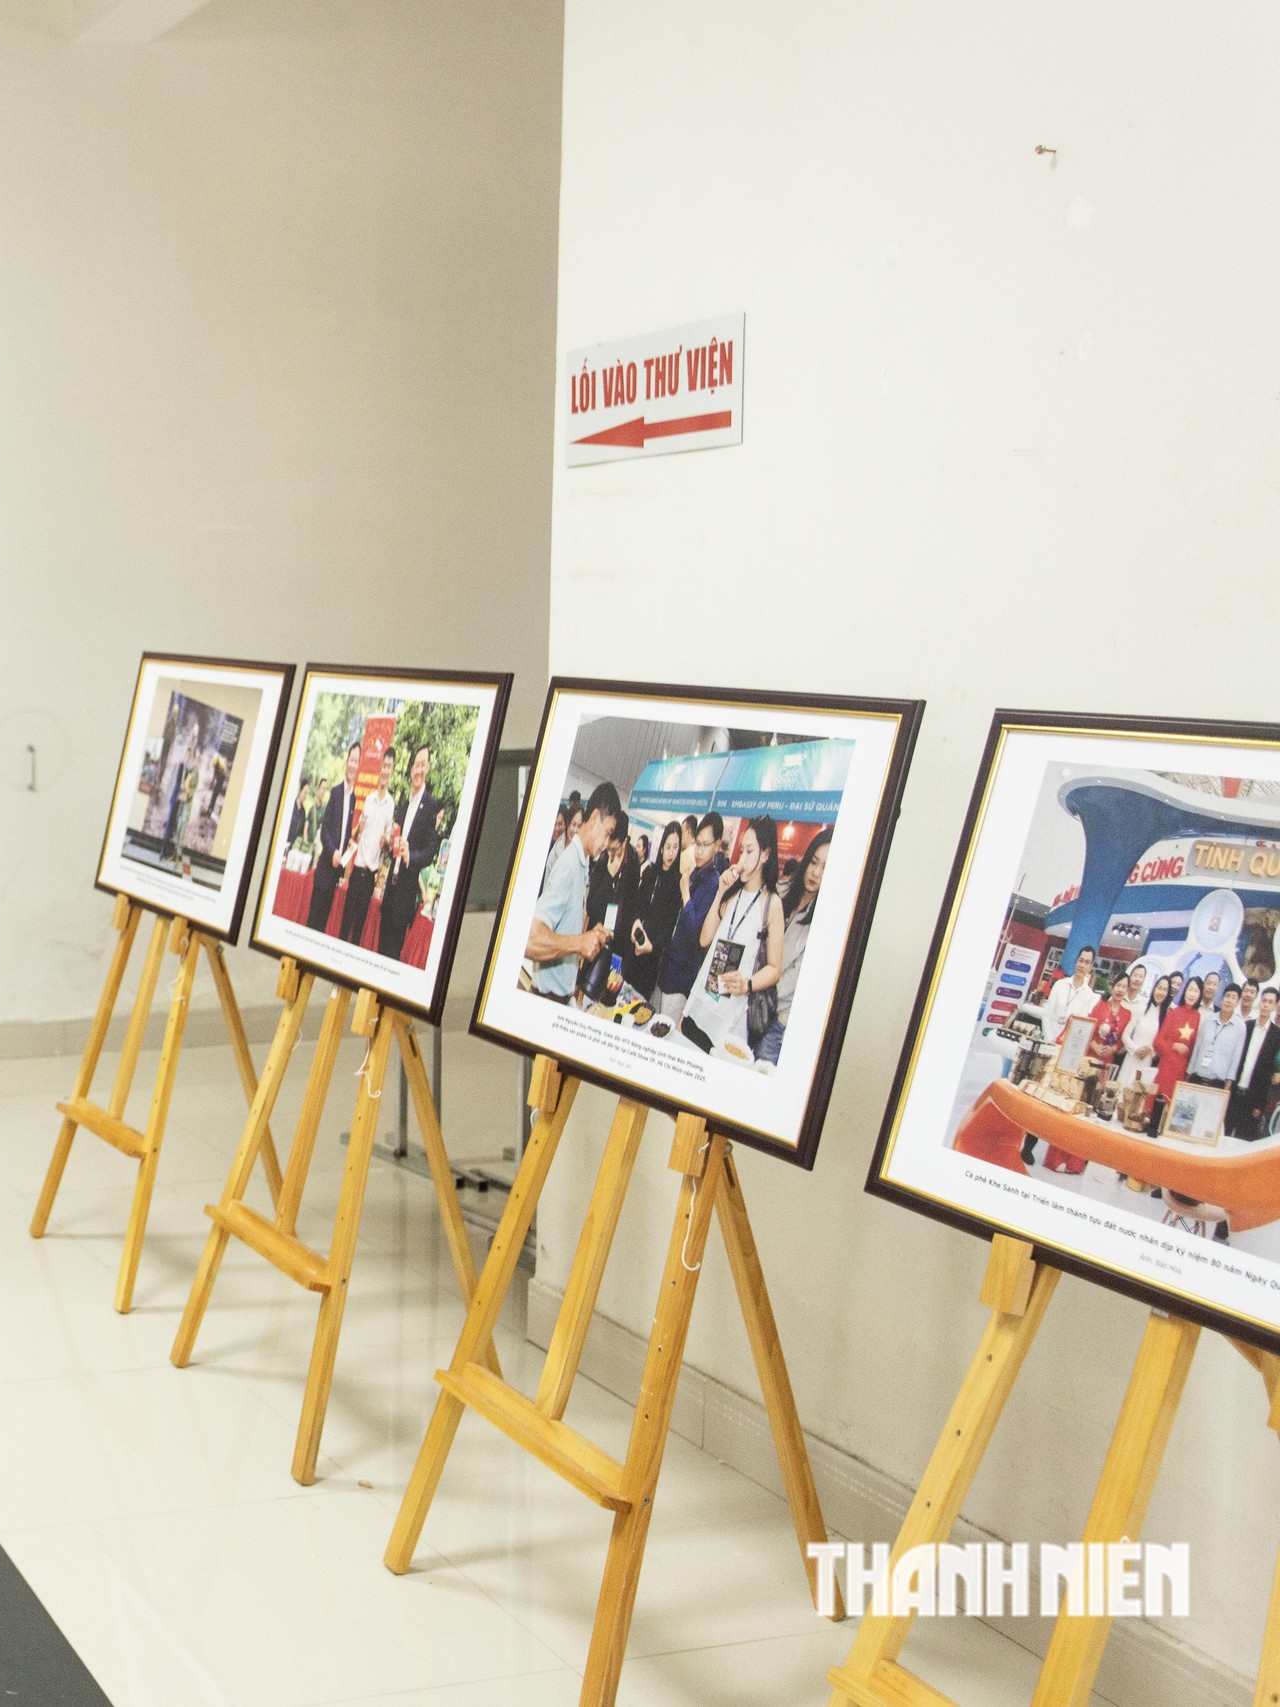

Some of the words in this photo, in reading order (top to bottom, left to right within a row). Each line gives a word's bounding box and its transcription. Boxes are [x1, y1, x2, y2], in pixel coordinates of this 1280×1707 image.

[571, 357, 596, 414] LỐI
[603, 359, 637, 408] VÀO
[644, 344, 682, 400] THƯ
[687, 336, 733, 394] VIỆN
[767, 801, 784, 810] PERU
[989, 1179, 1001, 1189] Khe
[1003, 1183, 1020, 1195] Sanh
